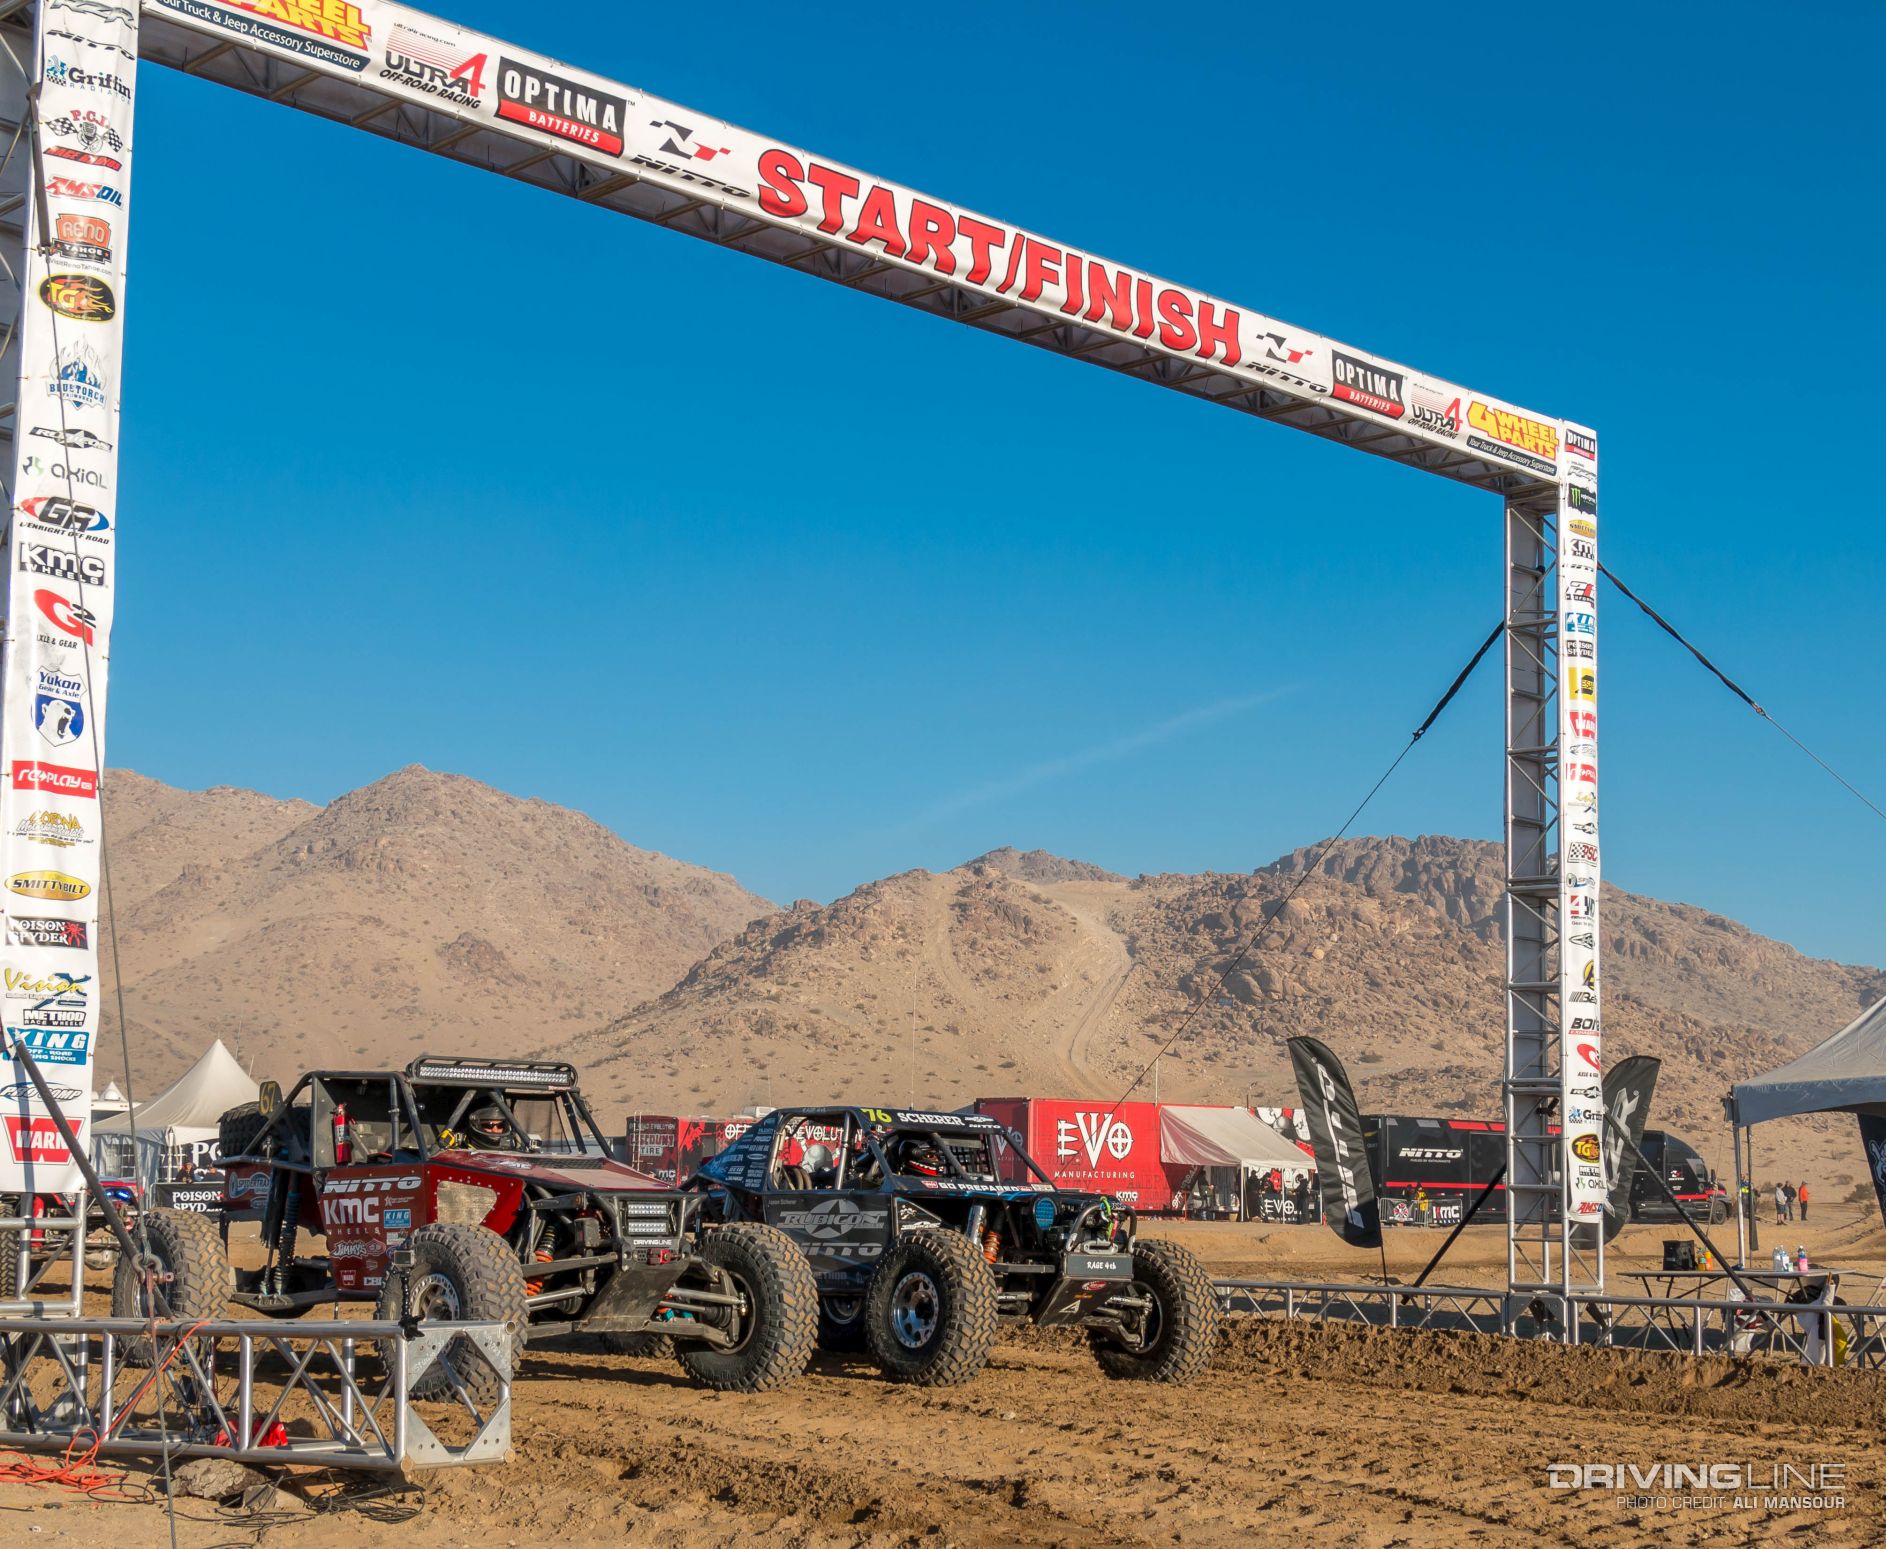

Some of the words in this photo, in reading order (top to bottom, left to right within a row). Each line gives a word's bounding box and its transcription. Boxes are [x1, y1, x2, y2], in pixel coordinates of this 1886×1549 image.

[182, 0, 211, 19] Truck
[212, 11, 222, 23] &
[222, 15, 249, 32] Jeep
[250, 24, 304, 51] Accessory
[305, 41, 360, 69] Superstore
[68, 67, 132, 99] Griffin
[379, 70, 437, 93] OFF-ROAD
[437, 89, 481, 109] RACING
[503, 69, 618, 134] OPTIMA
[528, 111, 600, 144] BATTERIES
[629, 154, 751, 199] NITTO
[46, 176, 122, 207] AMSOIL
[61, 221, 105, 243] RENO
[64, 244, 103, 256] TAHOE
[757, 148, 1240, 367] START/FINISH
[1246, 361, 1328, 394] NITTO
[1335, 357, 1399, 402] OPTIMA
[1349, 391, 1391, 413] BATTERIES
[1407, 418, 1437, 432] OFF-ROAD
[1435, 427, 1459, 440] RACING
[1466, 400, 1500, 439] 4
[1494, 408, 1559, 446] WHEEL
[1499, 426, 1557, 462] PARTS
[1567, 431, 1595, 453] OPTIMA
[1468, 438, 1481, 448] Your
[1480, 441, 1494, 452] Truck
[1497, 447, 1508, 459] Jeep
[1508, 452, 1532, 467] Accessory
[1530, 459, 1555, 474] Superstore
[68, 531, 85, 540] OFF
[85, 534, 110, 545] ROAD
[25, 563, 100, 586] WHEELS
[51, 636, 57, 646] &
[59, 638, 78, 650] GEAR
[39, 684, 55, 693] Gear
[62, 690, 80, 699] Axle
[40, 671, 81, 691] Yukon
[13, 879, 86, 895] SMITTYBILT
[4, 967, 84, 993] Vision
[24, 1010, 85, 1022] METHOD
[37, 1087, 83, 1101] OMP
[260, 1082, 275, 1116] 67
[861, 1108, 892, 1123] 76
[896, 1112, 966, 1126] SCHERER
[16, 1130, 70, 1150] WARN
[641, 1146, 661, 1155] TIRE
[1057, 1112, 1134, 1170] EVO
[1575, 1141, 1592, 1158] TG
[1399, 1147, 1462, 1159] NITTO
[323, 1176, 422, 1194] NITTO
[1054, 1170, 1135, 1180] MANUFACTURING
[172, 1191, 221, 1202] POISON
[938, 1182, 957, 1190] GO
[958, 1183, 1019, 1192] PREPARED
[1115, 1191, 1138, 1199] KMC
[323, 1197, 380, 1225] KMC
[385, 1210, 410, 1220] KING
[783, 1213, 882, 1226] RUBICON
[326, 1226, 381, 1236] WHEELS
[1087, 1261, 1104, 1270] RAGE
